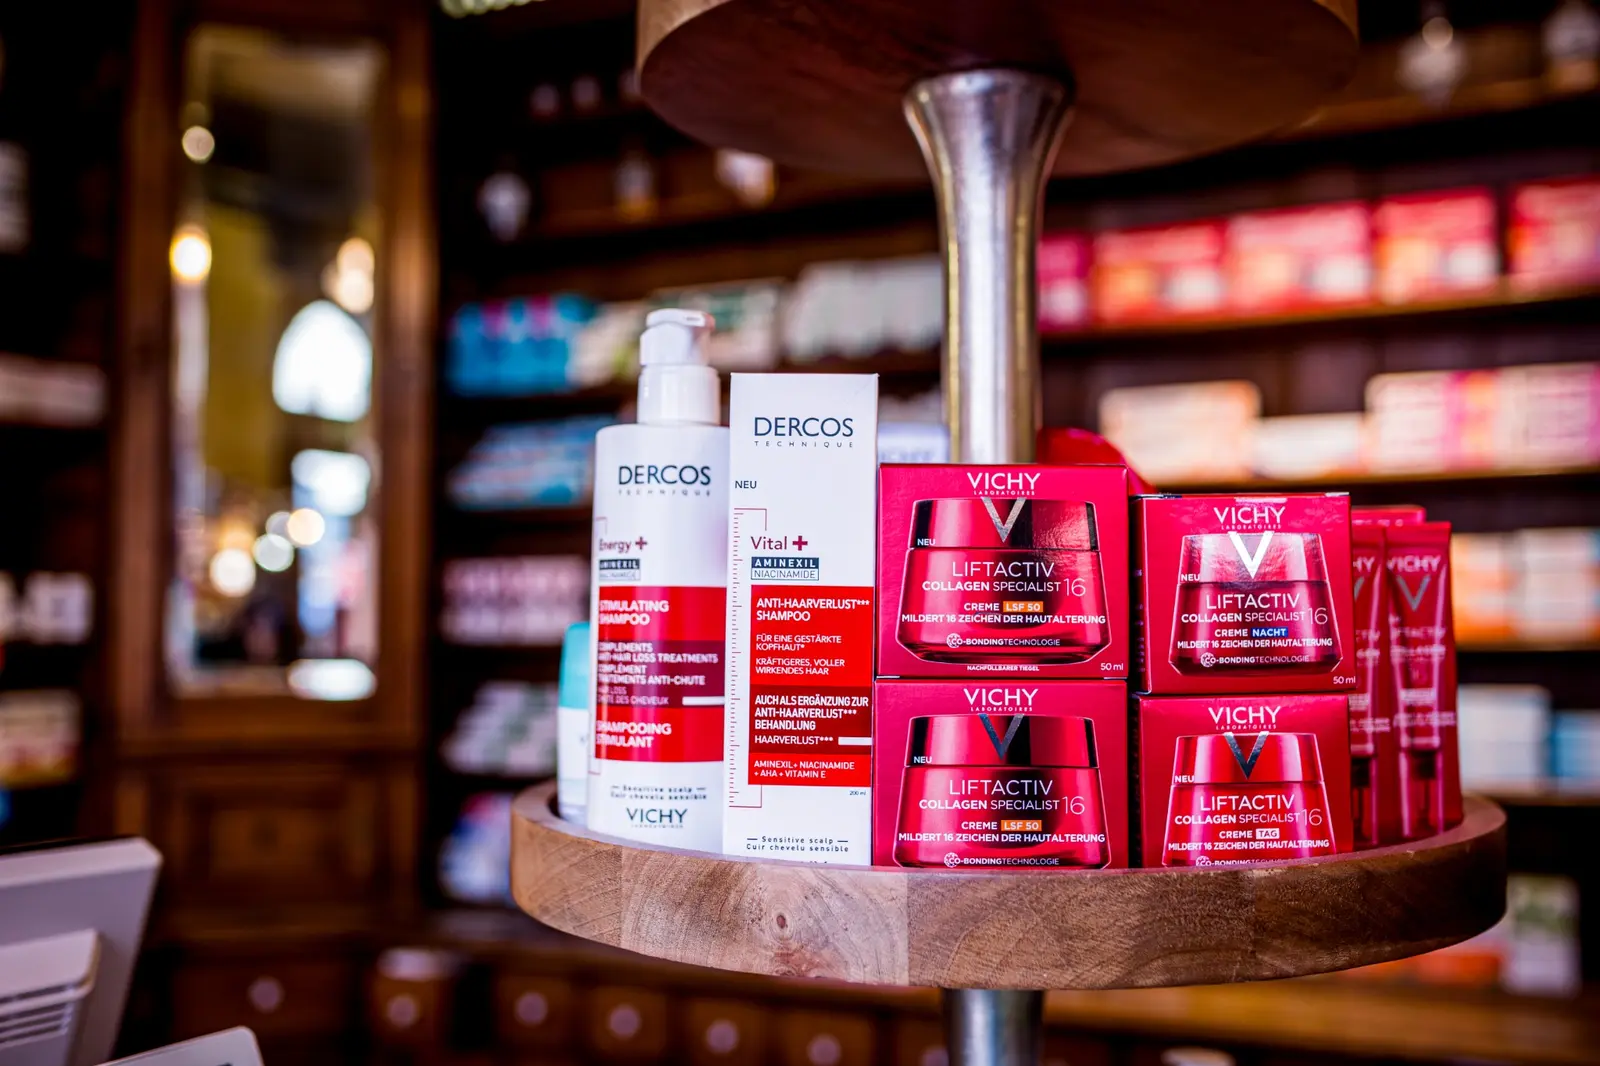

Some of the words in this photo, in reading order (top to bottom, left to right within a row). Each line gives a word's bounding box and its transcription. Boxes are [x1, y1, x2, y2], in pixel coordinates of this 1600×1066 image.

[755, 417, 853, 437] DERCOS
[619, 465, 711, 485] DERCOS
[735, 481, 757, 489] NEU
[967, 473, 1040, 490] VICHY
[1214, 507, 1285, 524] VICHY
[599, 539, 631, 553] Energy
[751, 536, 787, 550] Vital
[917, 538, 936, 546] NEU
[755, 558, 816, 567] AMINEXIL
[1386, 556, 1441, 572] VICHY
[754, 570, 815, 578] NIACINAMIDE
[952, 562, 1055, 577] LIFTACTIV
[1180, 573, 1200, 581] NEU
[922, 581, 990, 591] COLLAGEN
[993, 581, 1061, 592] SPECIALIST
[1064, 578, 1086, 597] 16
[599, 600, 669, 612] STIMULATING
[1207, 594, 1300, 609] LIFTACTIV
[964, 603, 999, 612] CREME
[1006, 603, 1025, 611] LSF
[1028, 603, 1040, 612] 50
[599, 613, 650, 625] SHAMPOO
[756, 611, 810, 621] SHAMPOO
[902, 614, 945, 623] MILDERT
[947, 615, 956, 623] 16
[959, 614, 1001, 623] ZEICHEN
[1003, 615, 1023, 623] DER
[1026, 615, 1105, 624] HAUTALTERUNG
[1181, 612, 1242, 623] COLLAGEN
[1245, 611, 1306, 622] SPECIALIST
[1308, 608, 1328, 625] 16
[1215, 628, 1248, 637] CREME
[1253, 628, 1286, 637] NACHT
[756, 633, 772, 642] FÜR
[794, 634, 841, 643] GESTÄRKTE
[1177, 639, 1210, 648] MILDERT
[1212, 640, 1220, 648] 16
[1221, 639, 1253, 648] ZEICHEN
[1255, 639, 1270, 648] DER
[1271, 638, 1332, 648] HAUTALTERUNG
[633, 654, 656, 662] LOSS
[658, 654, 718, 663] TREATMENTS
[756, 657, 811, 666] KRÄFTIGERES,
[1101, 663, 1111, 671] 50
[648, 676, 705, 685] ANTI-CHUTE
[1333, 676, 1345, 684] 50
[755, 695, 778, 705] AUCH
[780, 696, 797, 705] ALS
[798, 694, 850, 706] ERGÄNZUNG
[852, 697, 868, 706] ZUR
[964, 689, 1038, 705] VICHY
[1208, 707, 1281, 725] VICHY
[596, 720, 671, 735] SHAMPOOING
[755, 721, 815, 730] BEHANDLUNG
[596, 733, 654, 747] STIMULANT
[800, 761, 855, 769] NIACINAMIDE
[914, 756, 932, 764] NEU
[785, 770, 818, 778] VITAMIN
[1175, 775, 1195, 783] NEU
[949, 780, 1053, 795] LIFTACTIV
[919, 799, 987, 810] COLLAGEN
[990, 800, 1059, 810] SPECIALIST
[1062, 796, 1085, 815] 16
[1200, 795, 1295, 811] LIFTACTIV
[626, 808, 688, 823] VICHY
[1175, 814, 1236, 825] COLLAGEN
[1239, 813, 1300, 823] SPECIALIST
[1302, 809, 1322, 826] 16
[962, 821, 997, 830] CREME
[1004, 822, 1023, 830] LSF
[1026, 822, 1039, 830] 50
[898, 833, 942, 842] MILDERT
[944, 834, 954, 842] 16
[956, 833, 999, 842] ZEICHEN
[1001, 834, 1021, 842] DER
[1024, 834, 1105, 843] HAUTALTERUNG
[1219, 831, 1253, 839] CREME
[1259, 830, 1277, 838] TAG
[1168, 843, 1202, 851] MILDERT
[1214, 842, 1247, 850] ZEICHEN
[1267, 840, 1329, 849] HAUTALTERUNG
